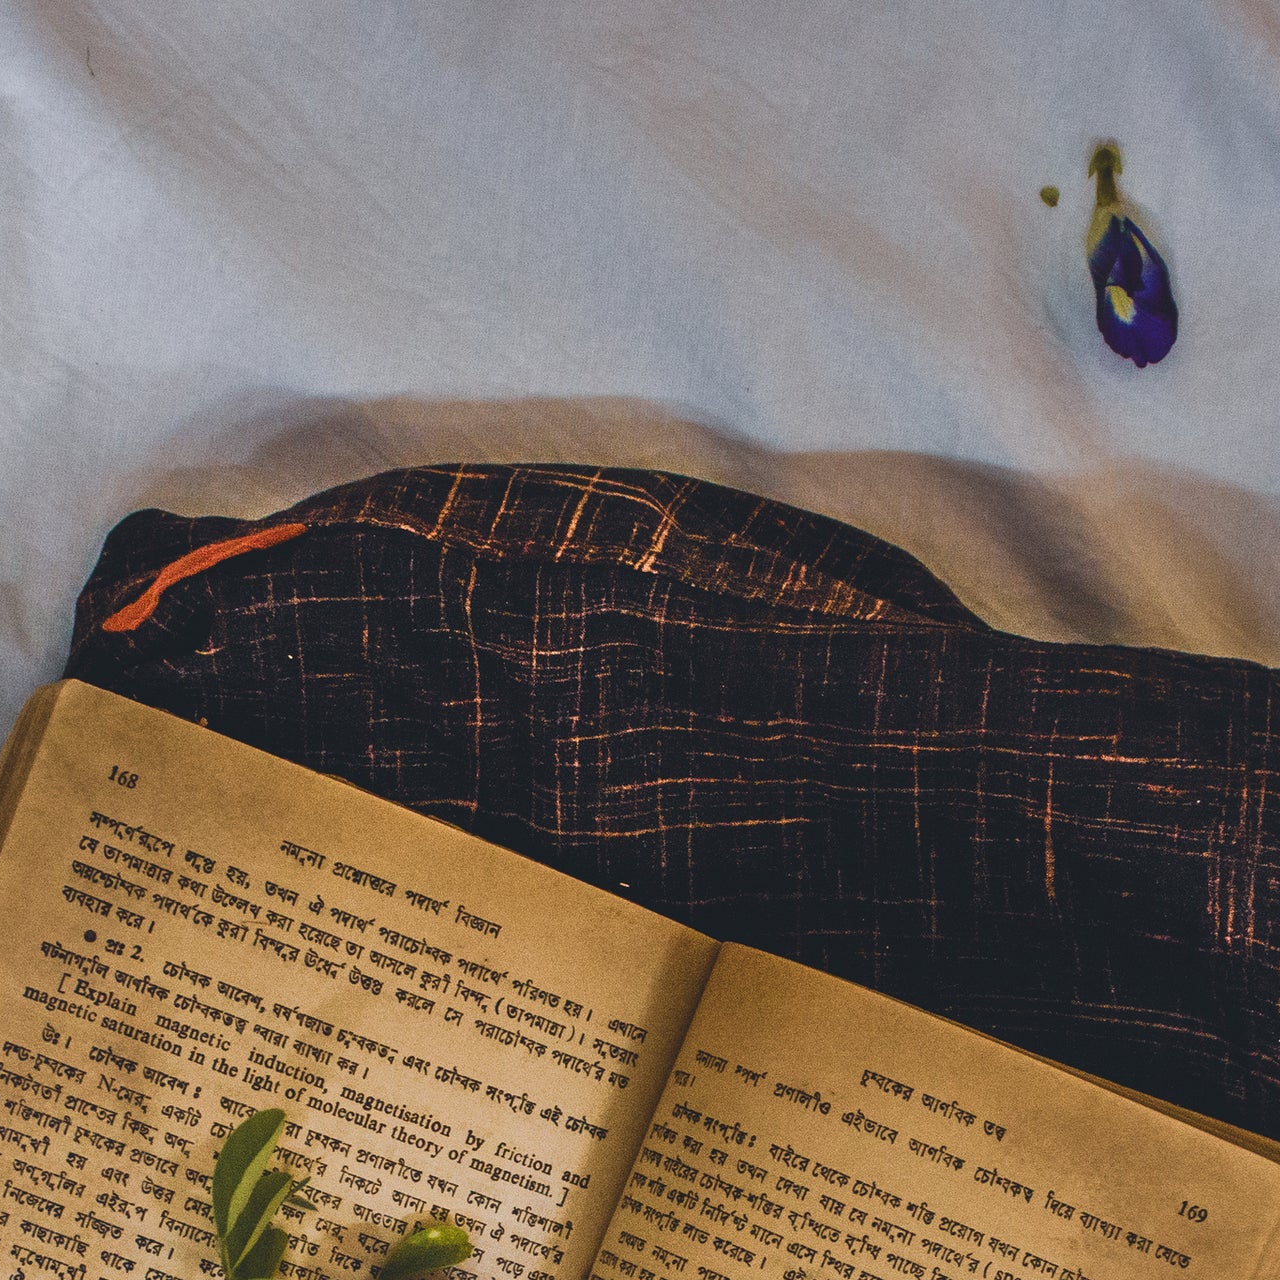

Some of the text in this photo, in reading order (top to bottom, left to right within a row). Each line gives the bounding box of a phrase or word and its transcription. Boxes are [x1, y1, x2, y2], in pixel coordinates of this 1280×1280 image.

[106, 763, 140, 790] 168
[21, 985, 553, 1198] magnetic saturation in the light of molecular theory of magnetism.
[72, 977, 591, 1190] Explain magnetic induction, magnetisation by friction and
[1176, 1199, 1209, 1224] 169
